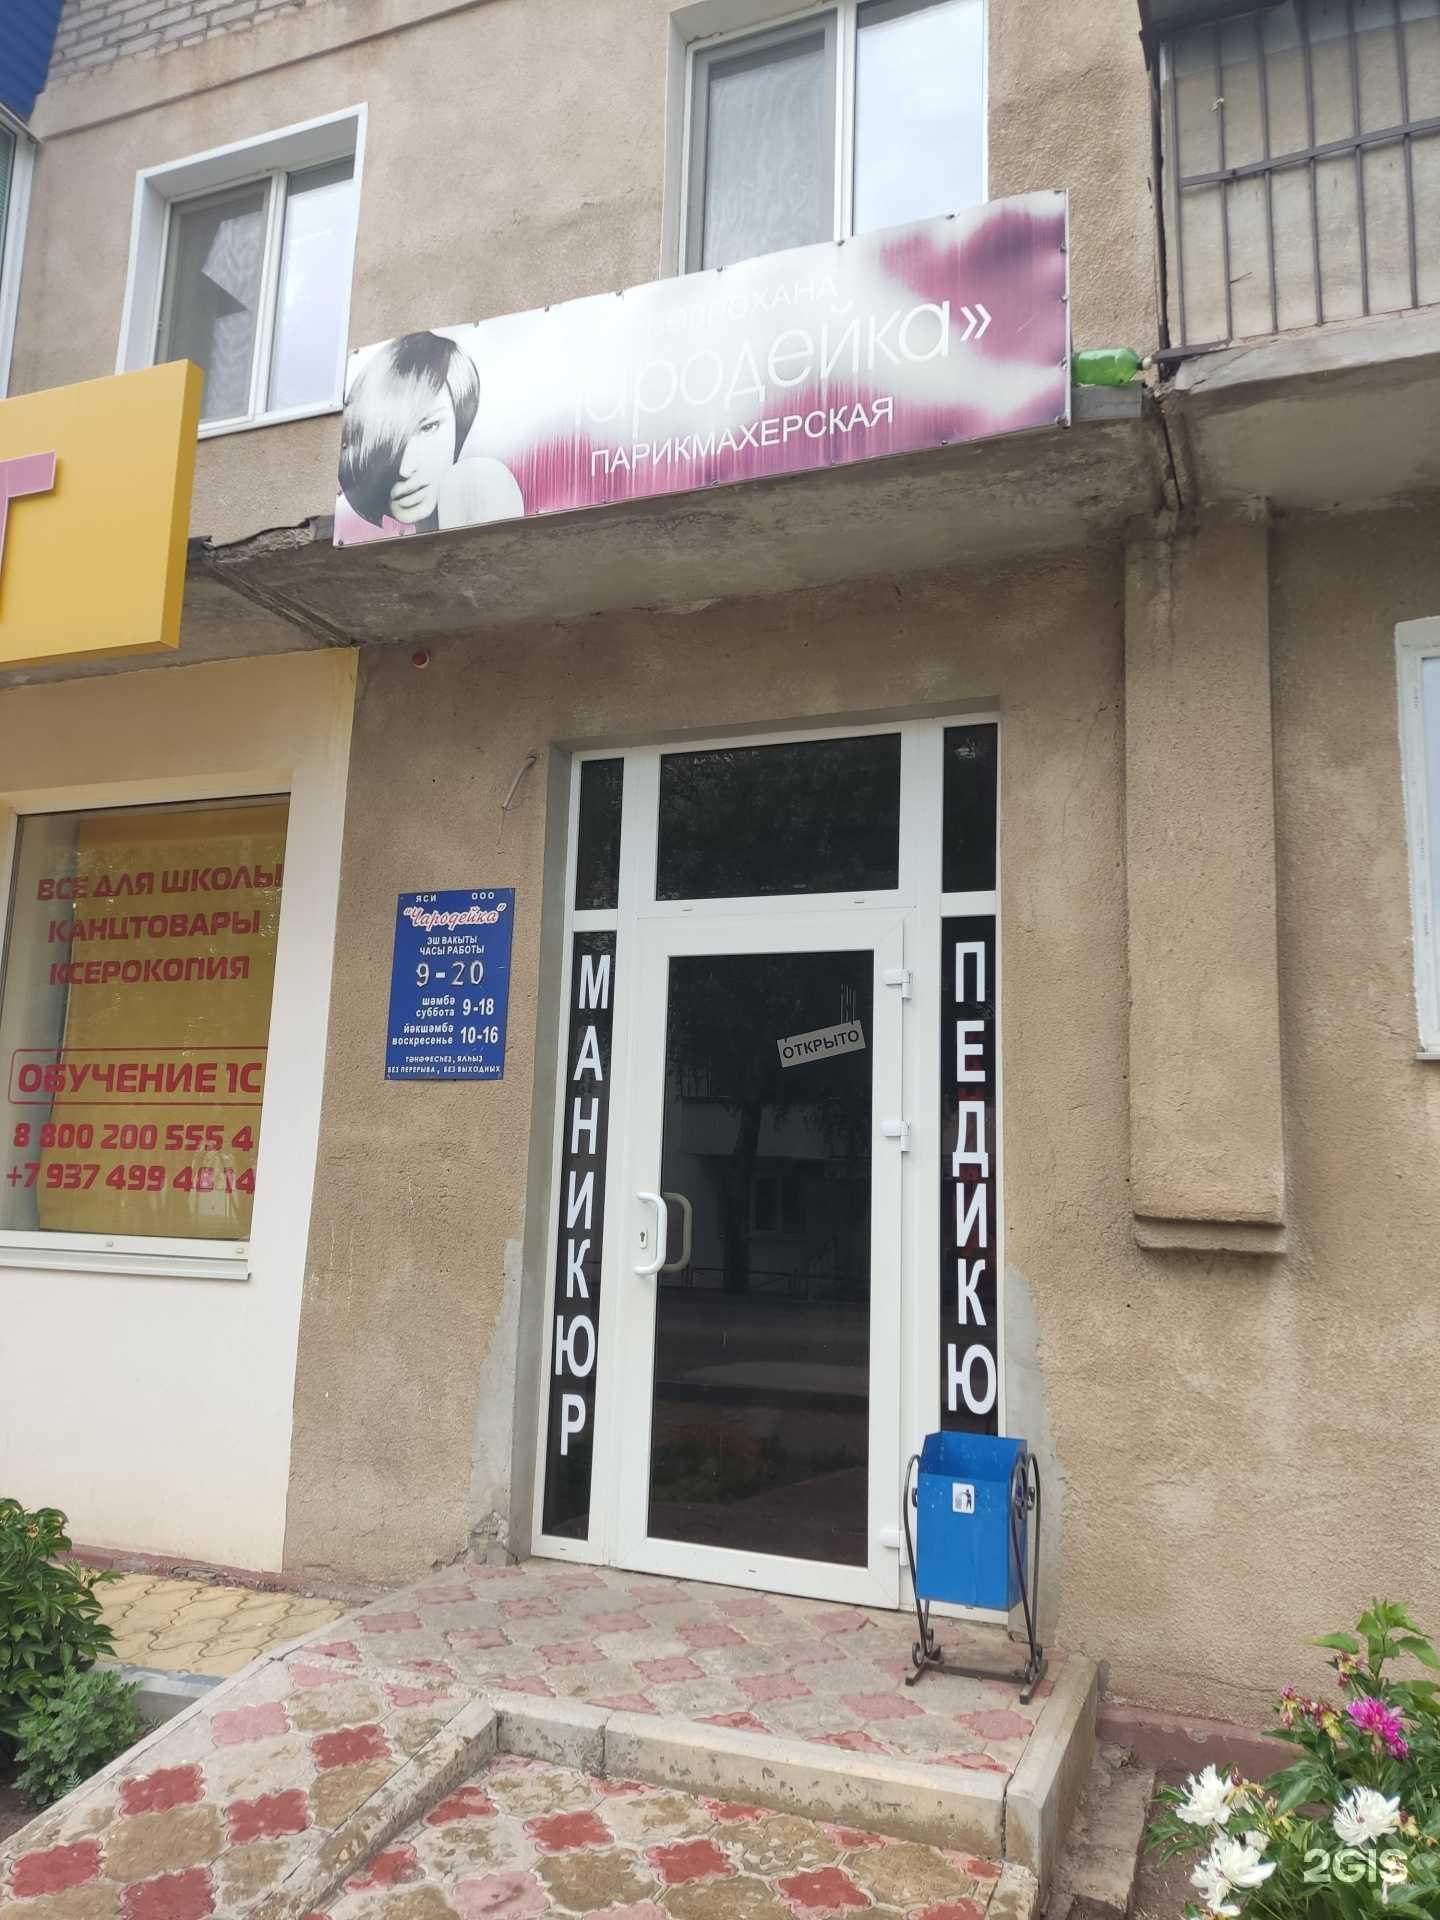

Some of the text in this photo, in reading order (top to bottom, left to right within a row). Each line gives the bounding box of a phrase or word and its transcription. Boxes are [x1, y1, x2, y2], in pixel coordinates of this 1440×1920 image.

[590, 397, 895, 478] ПАРИКМАХЕРСКАЯ
[37, 863, 285, 901] ВСЕ ДЛЯ ШКОЛЫ
[415, 891, 495, 904] ЯСИ ООО
[48, 910, 261, 943] КАНЦТОВАРЫ
[426, 936, 440, 945] ЭШ
[419, 944, 485, 956] ЧАСЫ РАБОТЫ
[50, 956, 250, 986] КСЕРОКОПИЯ
[415, 1006, 455, 1019] суббота
[462, 998, 494, 1016] 9-18
[392, 1036, 453, 1047] воскресенье
[460, 1026, 498, 1044] 10-16
[782, 1030, 859, 1059] ОТКРЫТО
[18, 1063, 217, 1094] ОБУЧЕНИЕ
[13, 1123, 253, 1152] 8 800 200 555 4
[7, 1163, 39, 1189] +7
[46, 1163, 100, 1190] 937
[105, 1165, 165, 1191] 499
[947, 941, 997, 1416] ПЕДИКЮ
[554, 954, 612, 1457] МАНИКЮР
